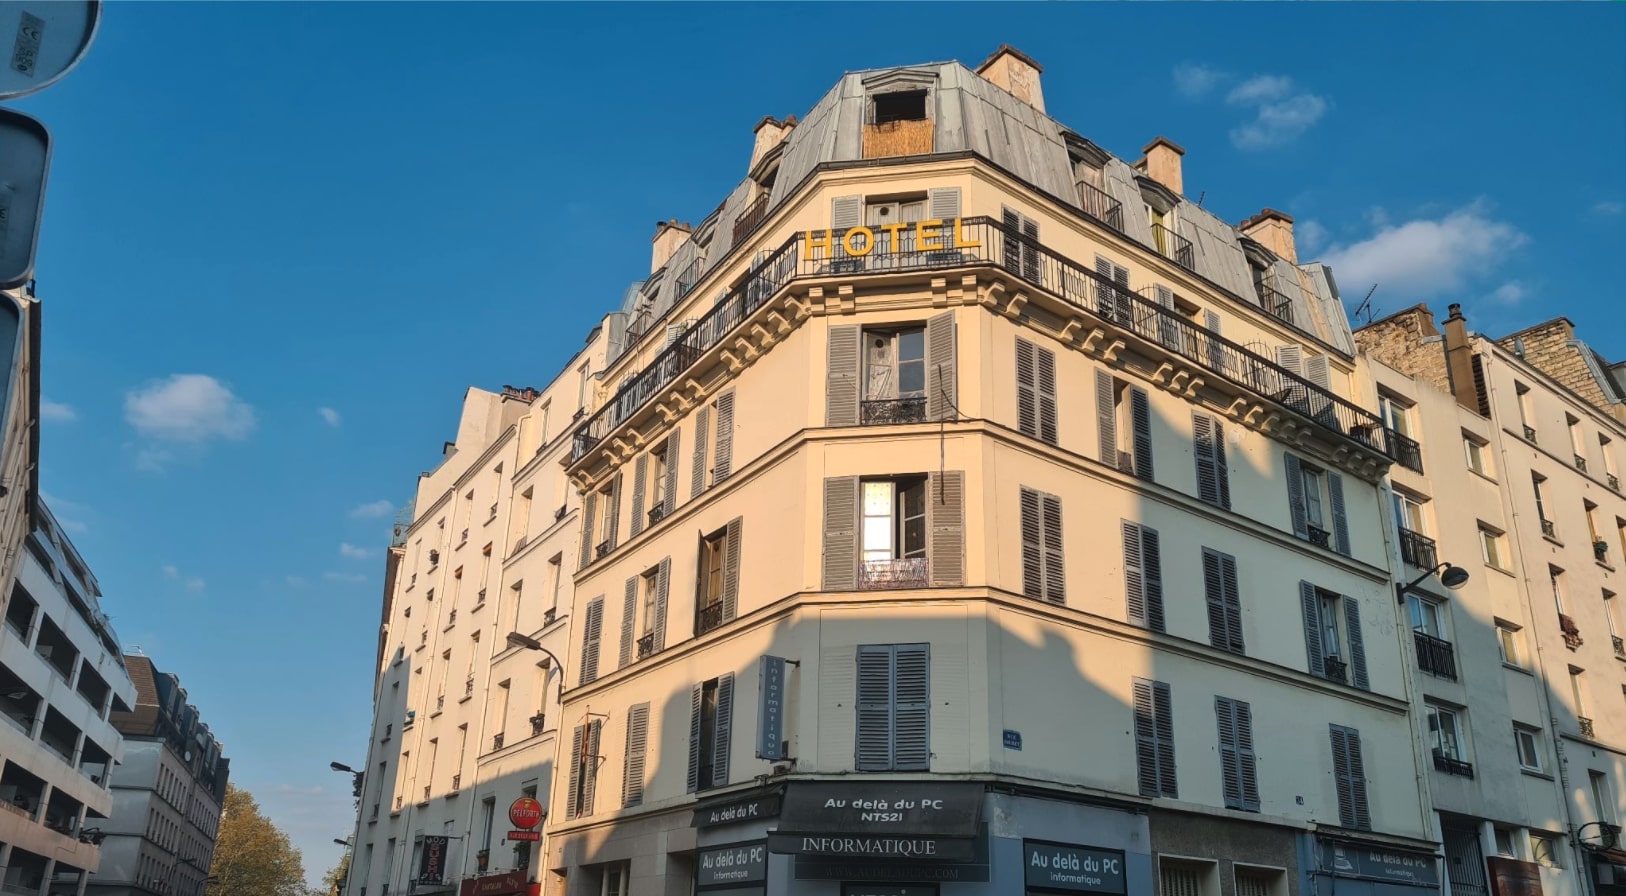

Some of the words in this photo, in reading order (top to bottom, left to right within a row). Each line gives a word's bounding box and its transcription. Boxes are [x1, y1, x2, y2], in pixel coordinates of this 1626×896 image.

[804, 217, 981, 261] HOTEL
[710, 811, 720, 823] Au
[720, 807, 736, 820] delà
[736, 805, 747, 818] du
[748, 803, 758, 817] PC
[824, 798, 846, 808] Au
[852, 799, 889, 810] delà
[894, 800, 915, 810] du
[921, 799, 944, 810] PC
[802, 837, 937, 857] INFORMATIQUE
[702, 854, 714, 869] Au
[715, 850, 734, 867] delà
[736, 849, 748, 865] du
[750, 847, 763, 863] PC
[1031, 851, 1048, 868] Au
[1052, 852, 1080, 871] delà
[1083, 856, 1099, 873] du
[1103, 858, 1119, 875] PC
